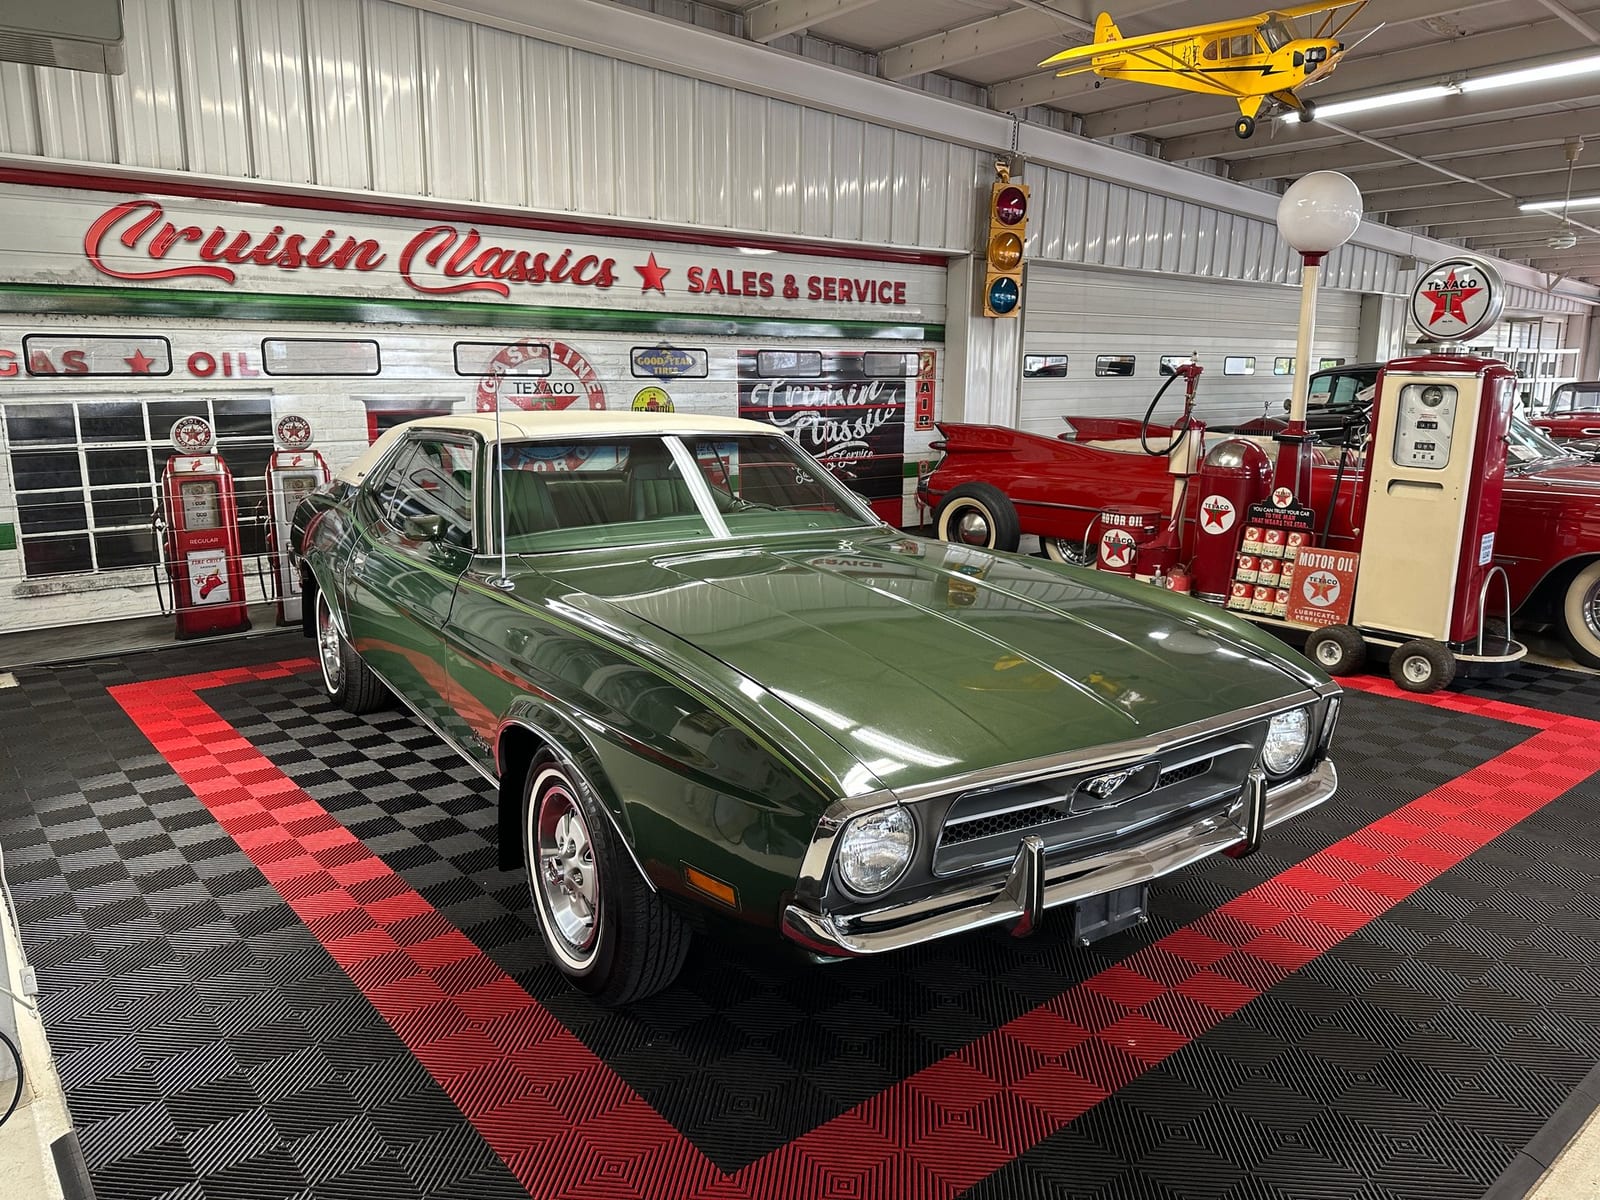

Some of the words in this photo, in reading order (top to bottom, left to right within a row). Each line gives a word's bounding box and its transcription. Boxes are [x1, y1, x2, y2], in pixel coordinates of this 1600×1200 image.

[85, 200, 386, 285] Cruisin
[399, 225, 619, 297] Classics
[687, 266, 774, 298] SALES
[782, 274, 799, 299] &
[807, 276, 907, 304] SERVICE
[1427, 279, 1477, 291] TEXACO
[0, 350, 89, 377] GAS
[187, 351, 260, 377] OIL
[513, 382, 575, 395] TEXACO
[750, 379, 886, 426] Cruisin
[919, 382, 930, 426] AIR
[1204, 502, 1229, 511] TEXACO
[1101, 512, 1125, 526] MOTOR
[1128, 515, 1143, 527] OIL
[190, 537, 219, 545] REGULAR
[1105, 535, 1133, 545] TEXACO
[1299, 552, 1334, 569] MOTOR
[1337, 557, 1353, 572] OIL
[1309, 576, 1338, 586] TEXACO
[1294, 608, 1341, 621] LUBRICATES
